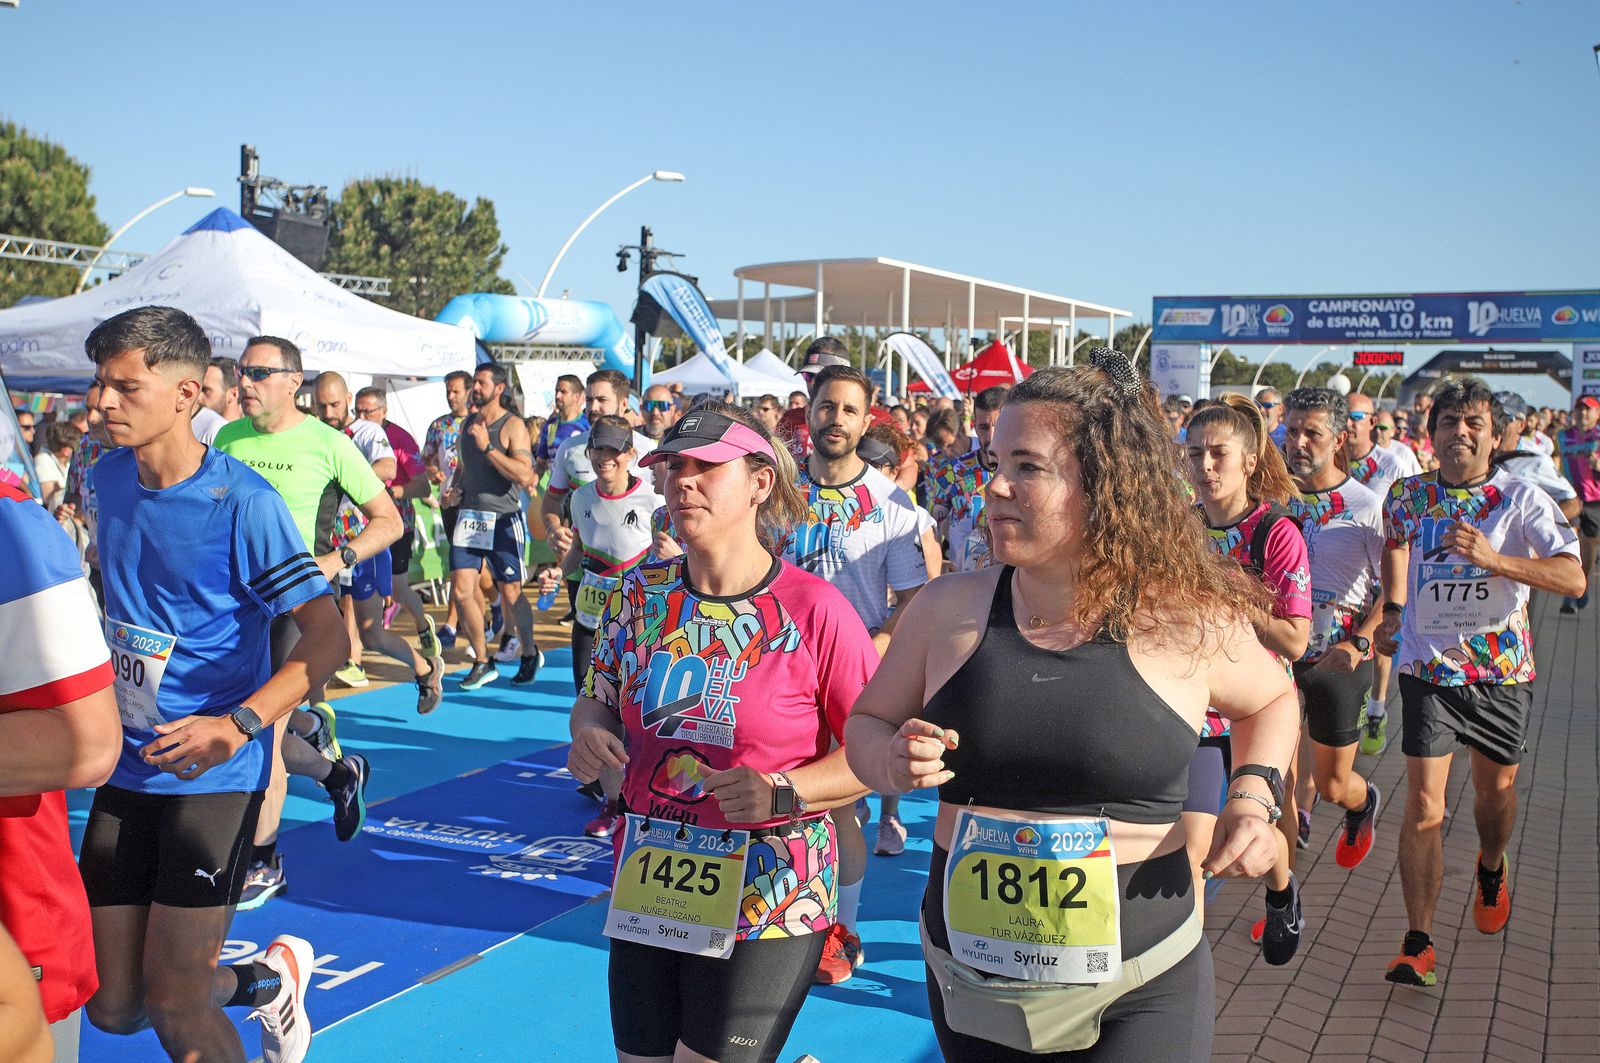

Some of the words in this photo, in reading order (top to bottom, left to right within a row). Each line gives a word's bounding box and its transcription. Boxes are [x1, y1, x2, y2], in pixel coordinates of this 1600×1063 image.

[1308, 299, 1415, 313] CAMPEONATO
[1496, 306, 1542, 322] HUELVA
[1307, 316, 1324, 328] de
[1327, 314, 1380, 328] ESPAÑA
[1389, 313, 1414, 329] 10
[1420, 311, 1453, 329] km
[1376, 330, 1413, 338] Absoluto
[463, 520, 488, 532] 1428
[584, 587, 607, 605] 119
[1430, 582, 1490, 602] 1775
[131, 635, 161, 653] 2023
[698, 722, 720, 735] PUERTA
[721, 727, 732, 737] DEL
[681, 730, 733, 747] DESCUBRIMIENTO
[384, 816, 527, 843] HUELVA
[650, 828, 672, 840] HUELVA
[698, 834, 735, 853] 2023
[975, 826, 1010, 844] HUELVA
[1051, 831, 1095, 852] 2023
[1017, 846, 1038, 855] WiHu
[638, 851, 721, 896] 1425
[971, 859, 1088, 909] 1812
[655, 896, 687, 909] BEATRIZ
[669, 908, 701, 923] LOZANO
[1008, 915, 1045, 928] LAURA
[657, 924, 689, 940] Syrluz
[990, 926, 1012, 939] TUR
[1013, 930, 1066, 945] VÁZQUEZ
[1013, 951, 1058, 966] Syrluz
